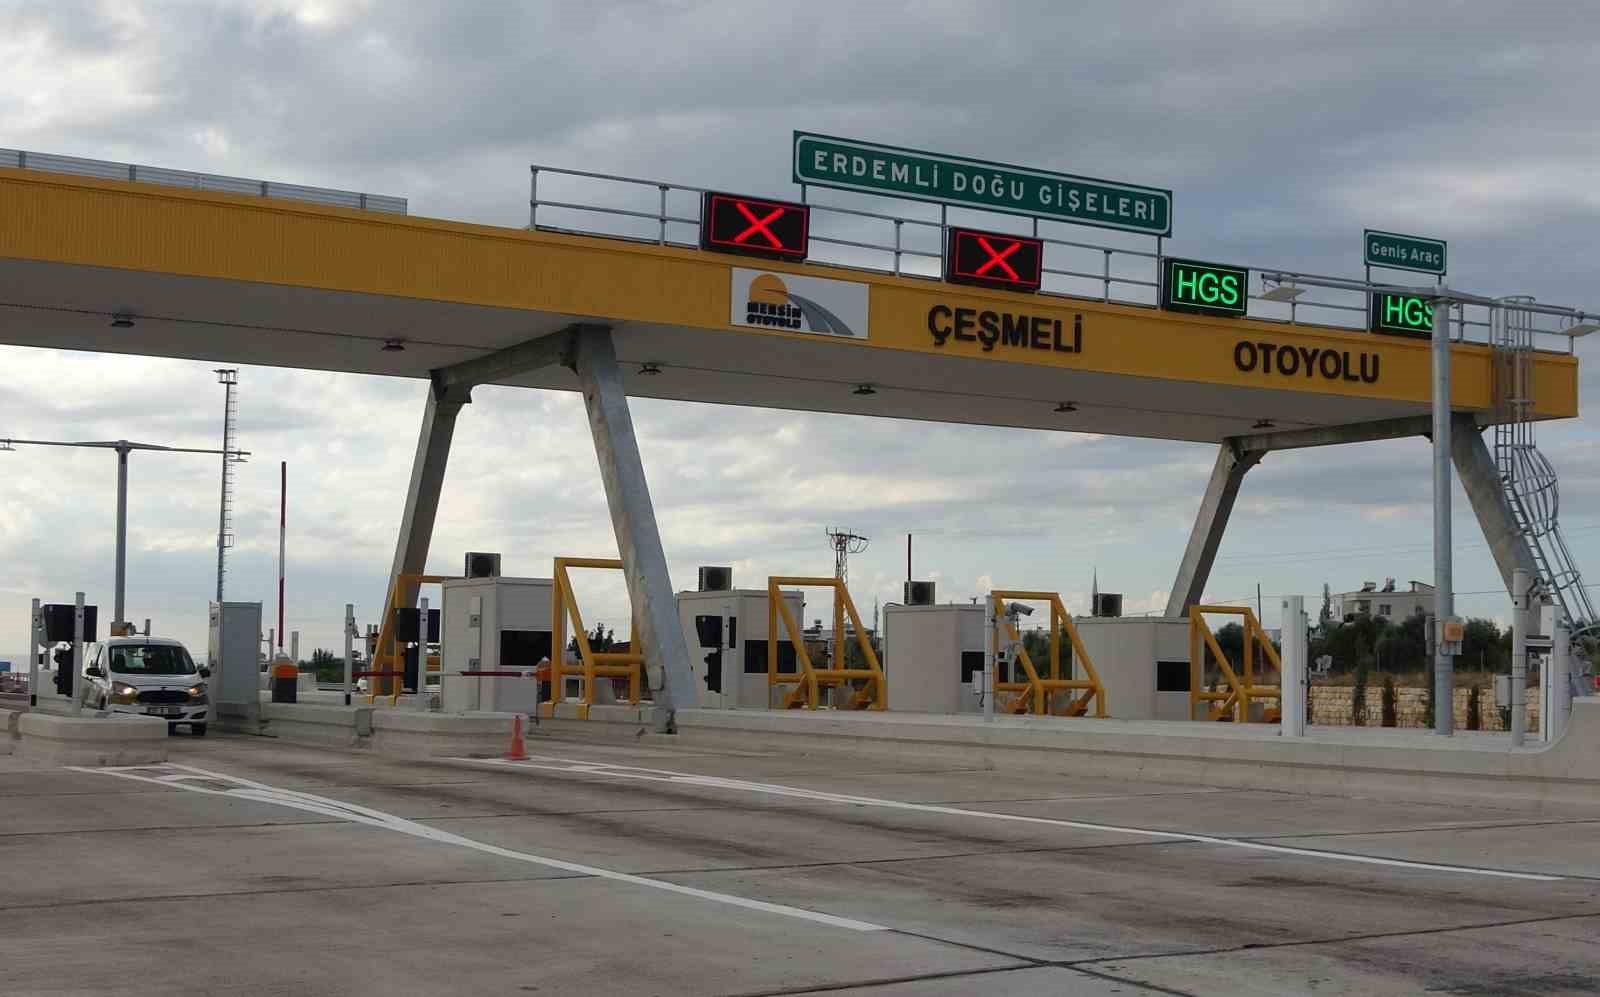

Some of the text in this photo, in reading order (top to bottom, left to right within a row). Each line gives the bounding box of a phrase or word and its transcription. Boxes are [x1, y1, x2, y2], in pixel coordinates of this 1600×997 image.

[813, 149, 1156, 221] ERDEMLİ DOĞU GİŞELERİ
[1410, 247, 1440, 265] Araç
[1177, 269, 1239, 305] HGS
[928, 305, 1380, 383] ÇEŞMELİ OTOYOLU
